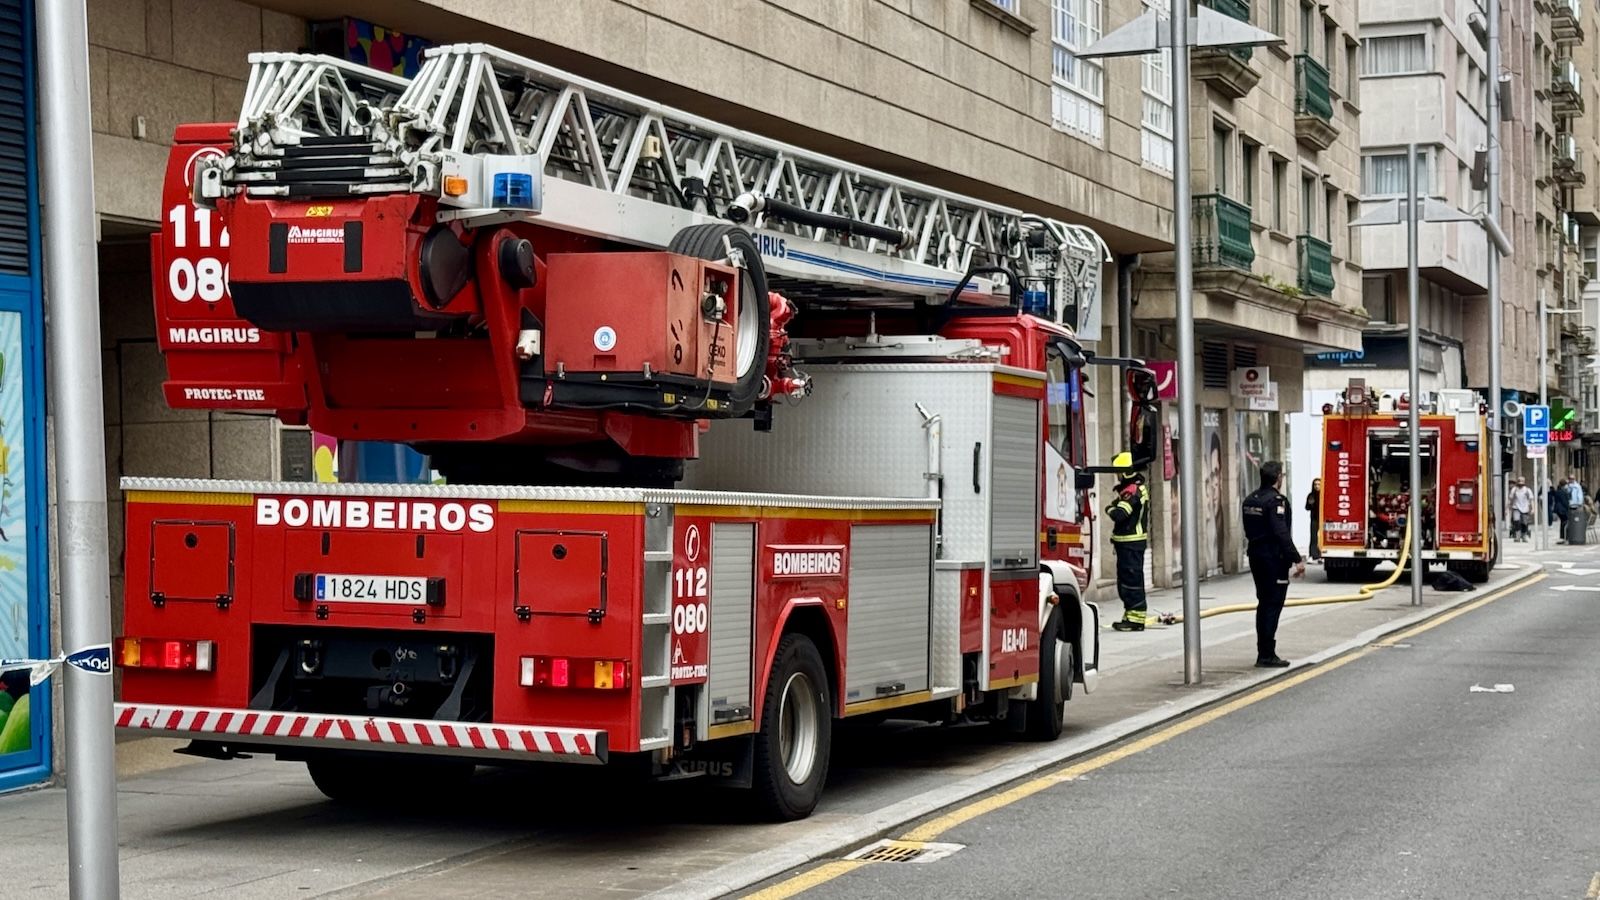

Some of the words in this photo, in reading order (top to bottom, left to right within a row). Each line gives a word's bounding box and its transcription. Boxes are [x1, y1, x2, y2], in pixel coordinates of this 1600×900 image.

[169, 257, 232, 302] 08
[169, 327, 261, 343] MAGIRUS
[184, 387, 266, 401] PROTEC-FIRE
[1530, 408, 1544, 426] P
[1338, 452, 1351, 517] BOMBEIROS
[256, 498, 495, 533] BOMBEIROS
[773, 551, 841, 575] BOMBEIROS
[331, 578, 377, 599] 1824
[385, 579, 422, 601] HDS
[675, 566, 708, 598] 112
[673, 602, 708, 635] 080
[671, 664, 708, 680] PROTEC-FIRE
